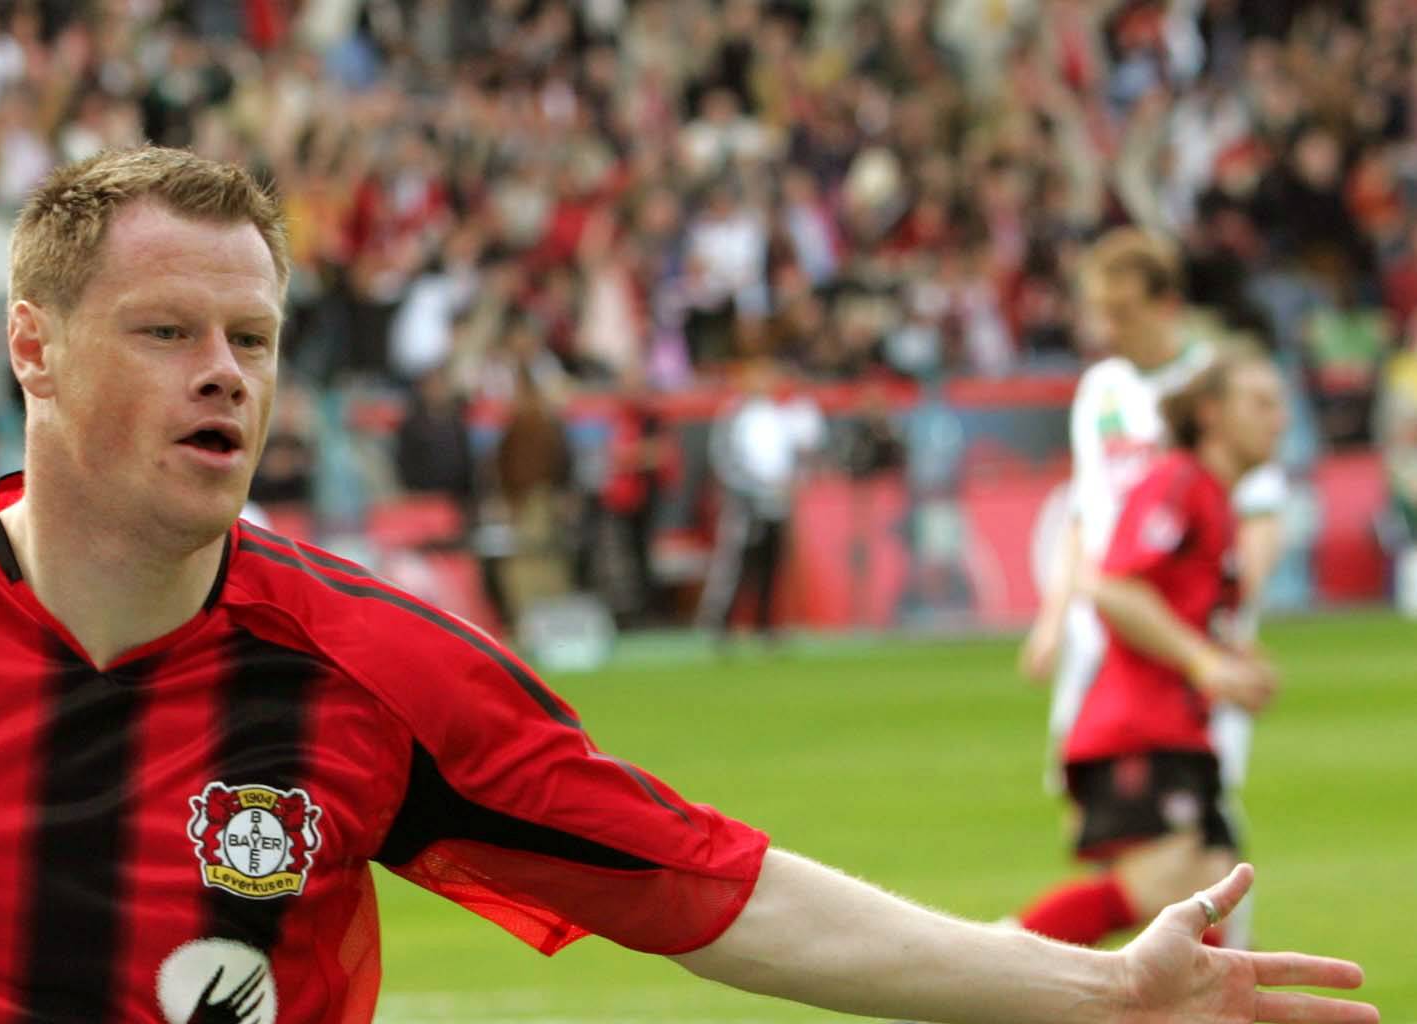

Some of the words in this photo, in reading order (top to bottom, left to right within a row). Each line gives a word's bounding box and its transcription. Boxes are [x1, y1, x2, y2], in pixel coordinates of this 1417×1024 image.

[243, 792, 273, 805] 1904
[228, 834, 283, 850] BAYER
[249, 810, 263, 874] BAYER
[212, 868, 293, 892] Leverkusen
